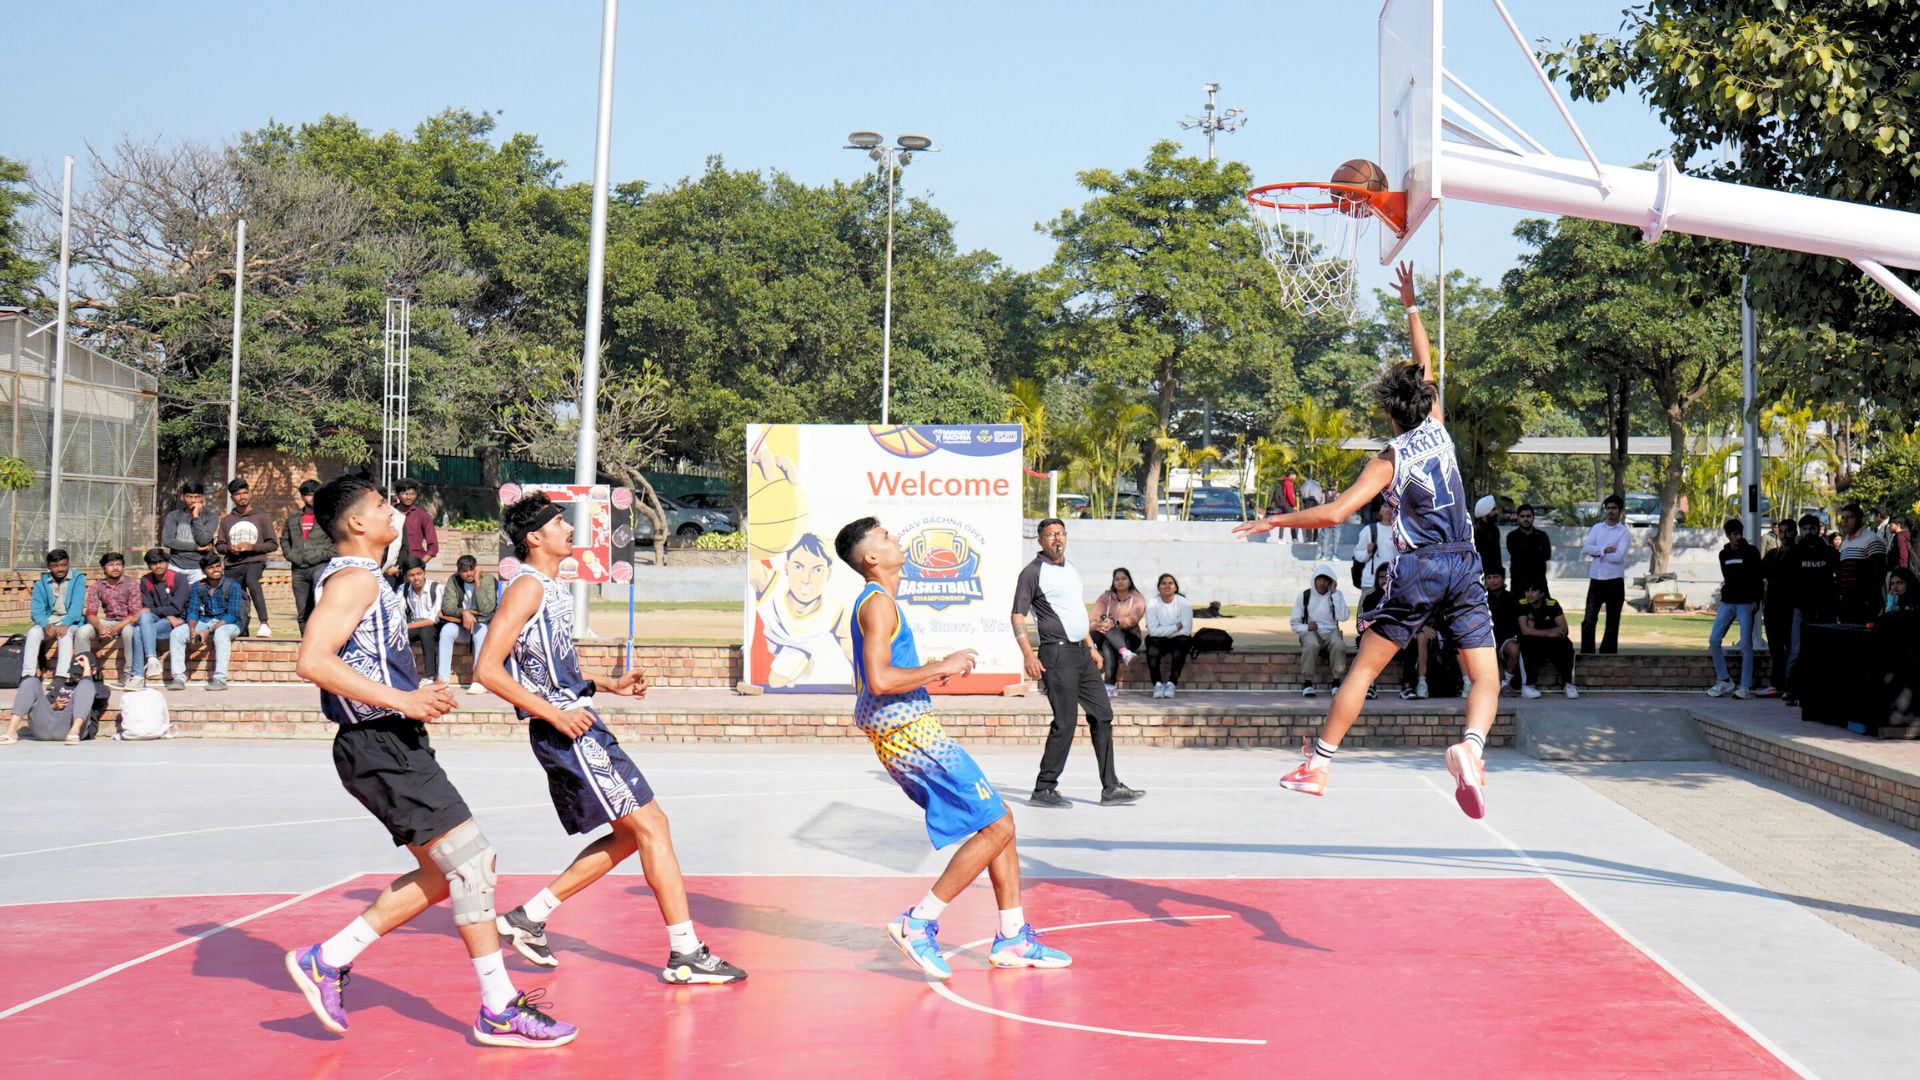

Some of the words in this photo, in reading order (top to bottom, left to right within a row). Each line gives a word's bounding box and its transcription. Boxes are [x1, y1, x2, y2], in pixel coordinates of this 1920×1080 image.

[867, 471, 1010, 497] Welcome
[1422, 456, 1455, 510] 1
[923, 516, 964, 529] RACHNA
[964, 524, 987, 546] OPEN
[897, 580, 982, 597] BASKETBALL
